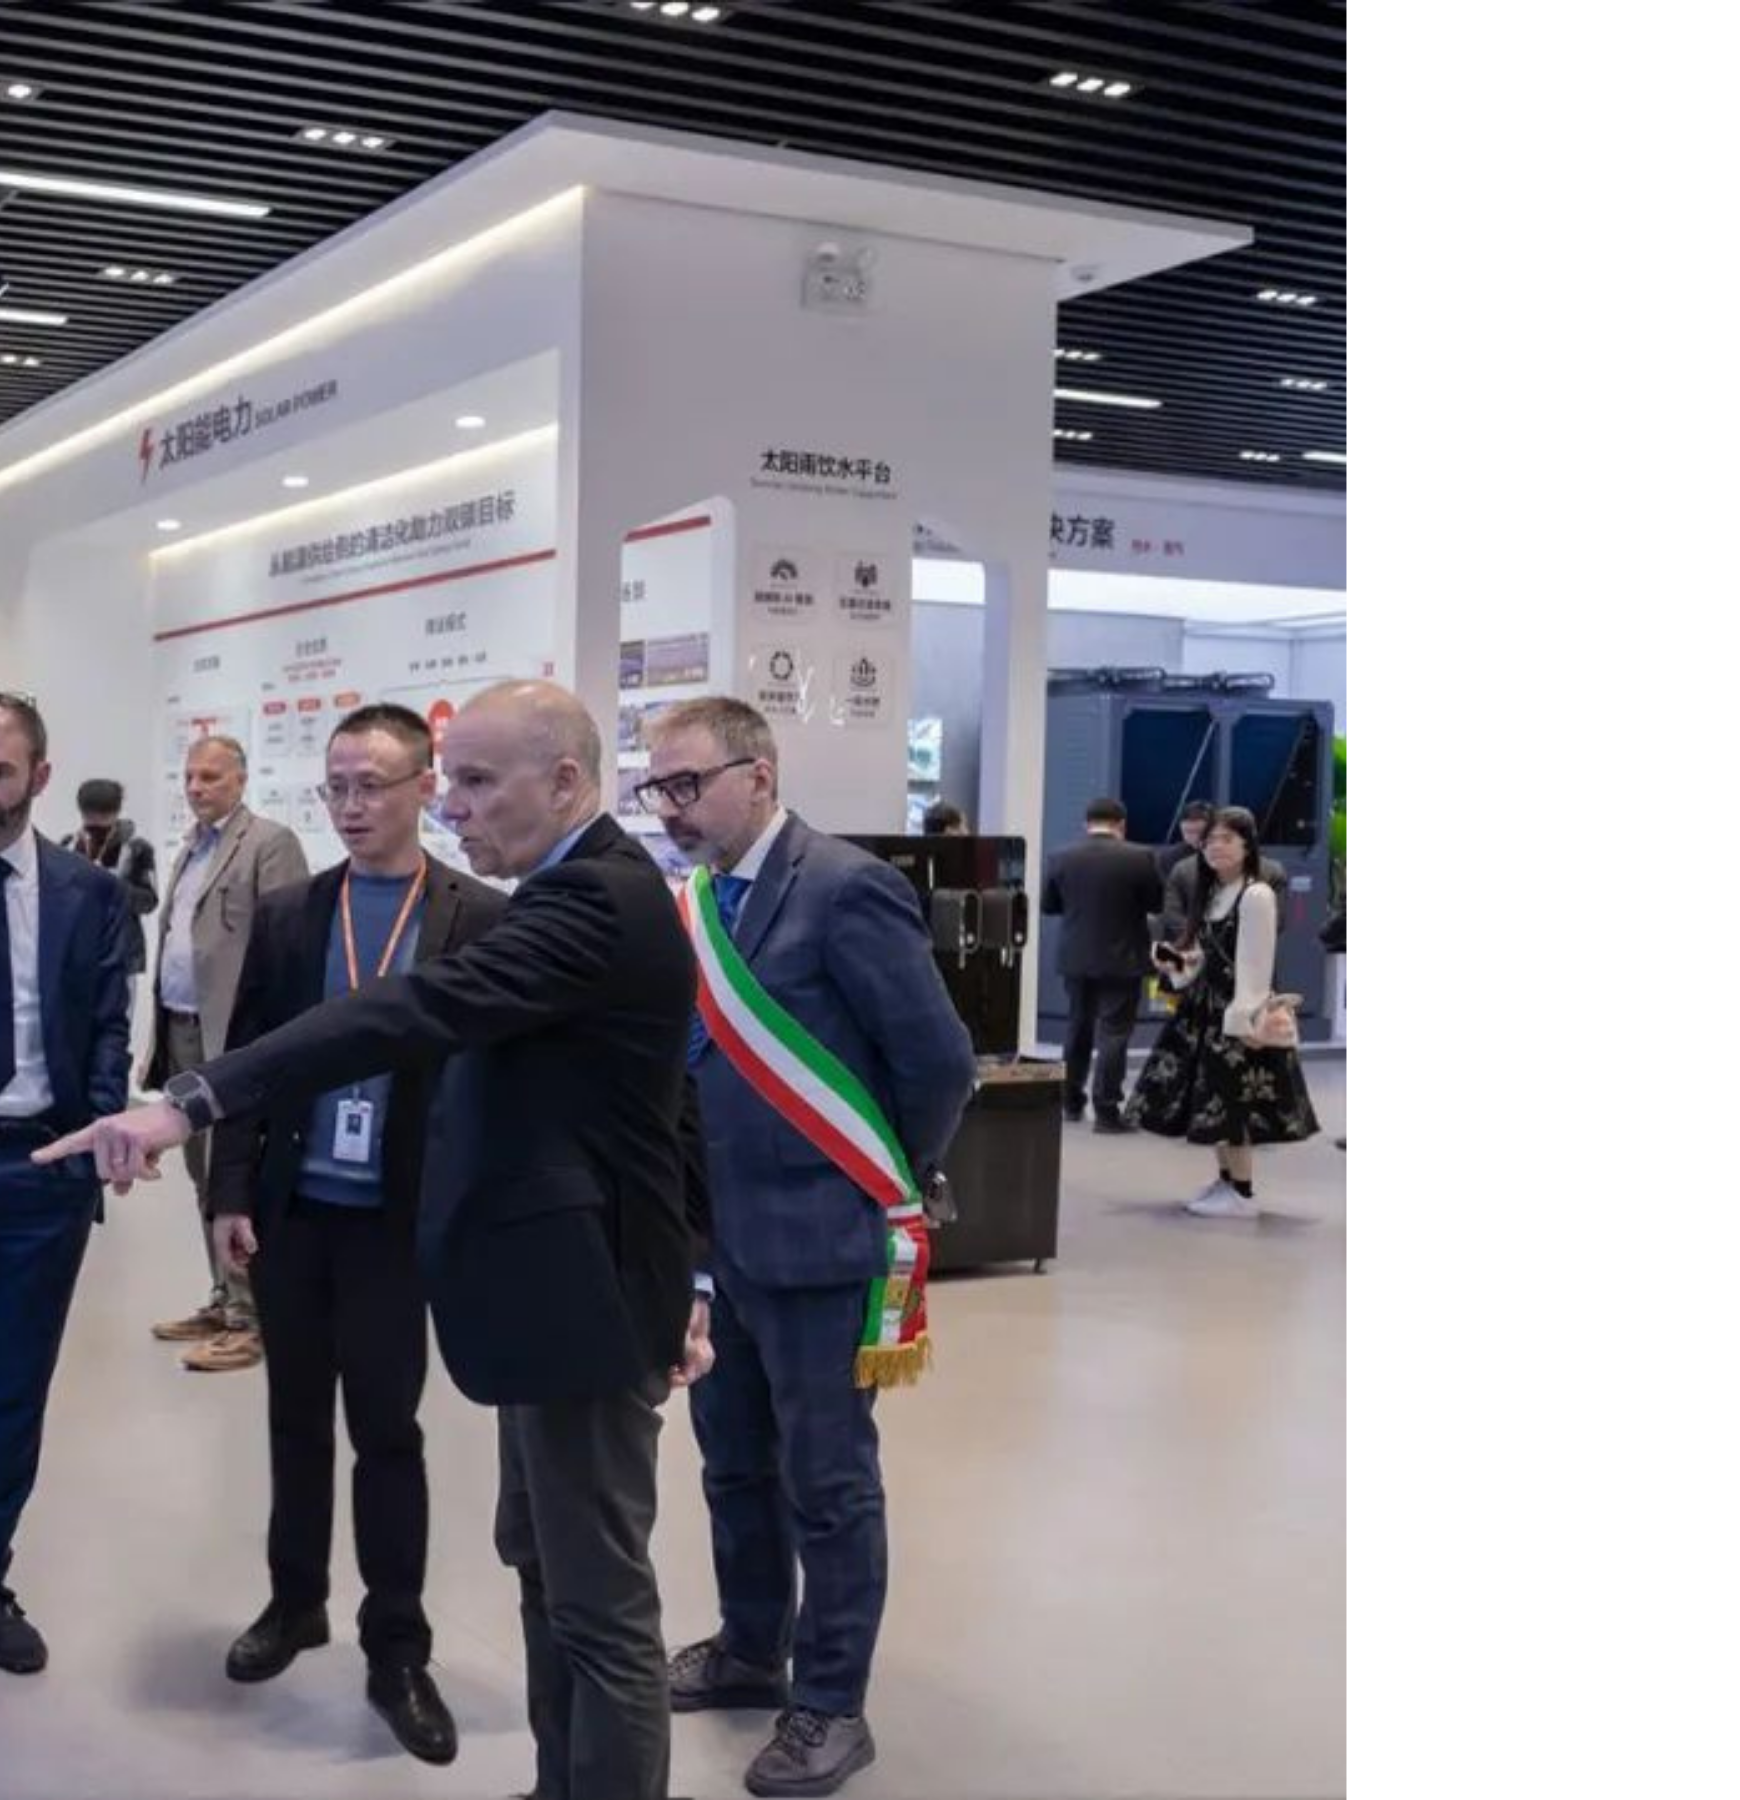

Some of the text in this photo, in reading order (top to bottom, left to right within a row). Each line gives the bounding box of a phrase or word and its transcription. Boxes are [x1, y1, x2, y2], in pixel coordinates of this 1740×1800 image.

[159, 395, 252, 468] 太阳能电力
[760, 449, 892, 484] 太阳雨饮水平台
